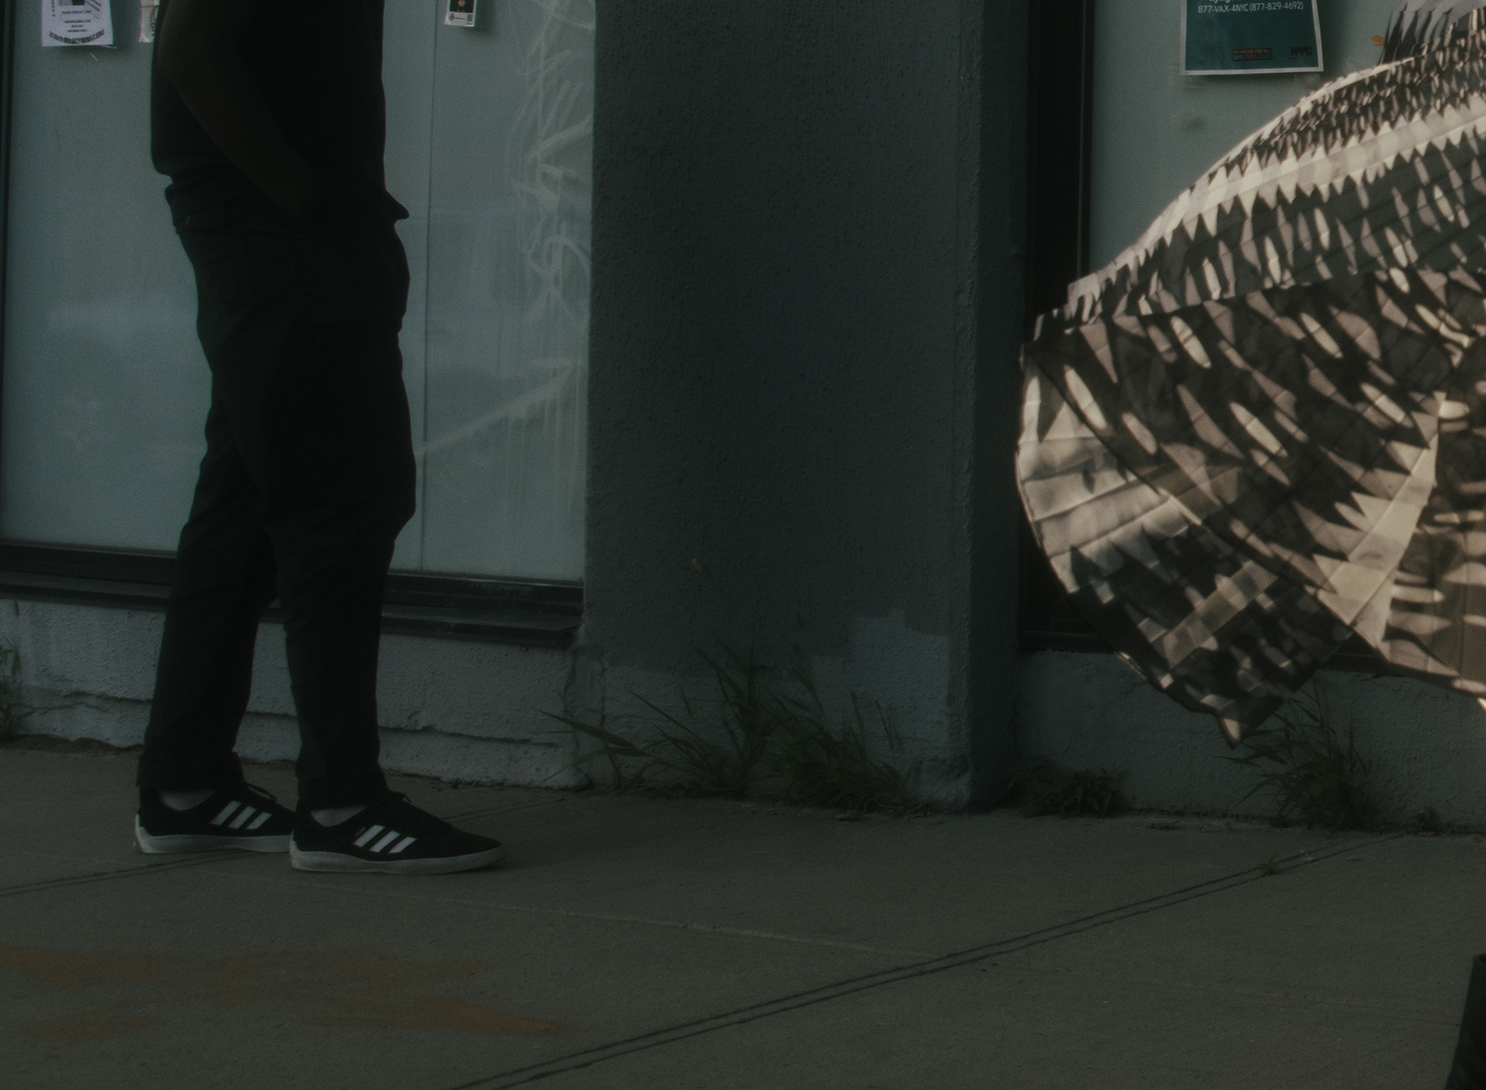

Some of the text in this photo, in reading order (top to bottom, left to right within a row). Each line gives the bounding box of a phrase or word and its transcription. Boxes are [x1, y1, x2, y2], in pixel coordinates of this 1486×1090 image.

[1198, 1, 1303, 14] 877-VAX-4NYC (877-829-4692)
[1290, 46, 1313, 56] NYC
